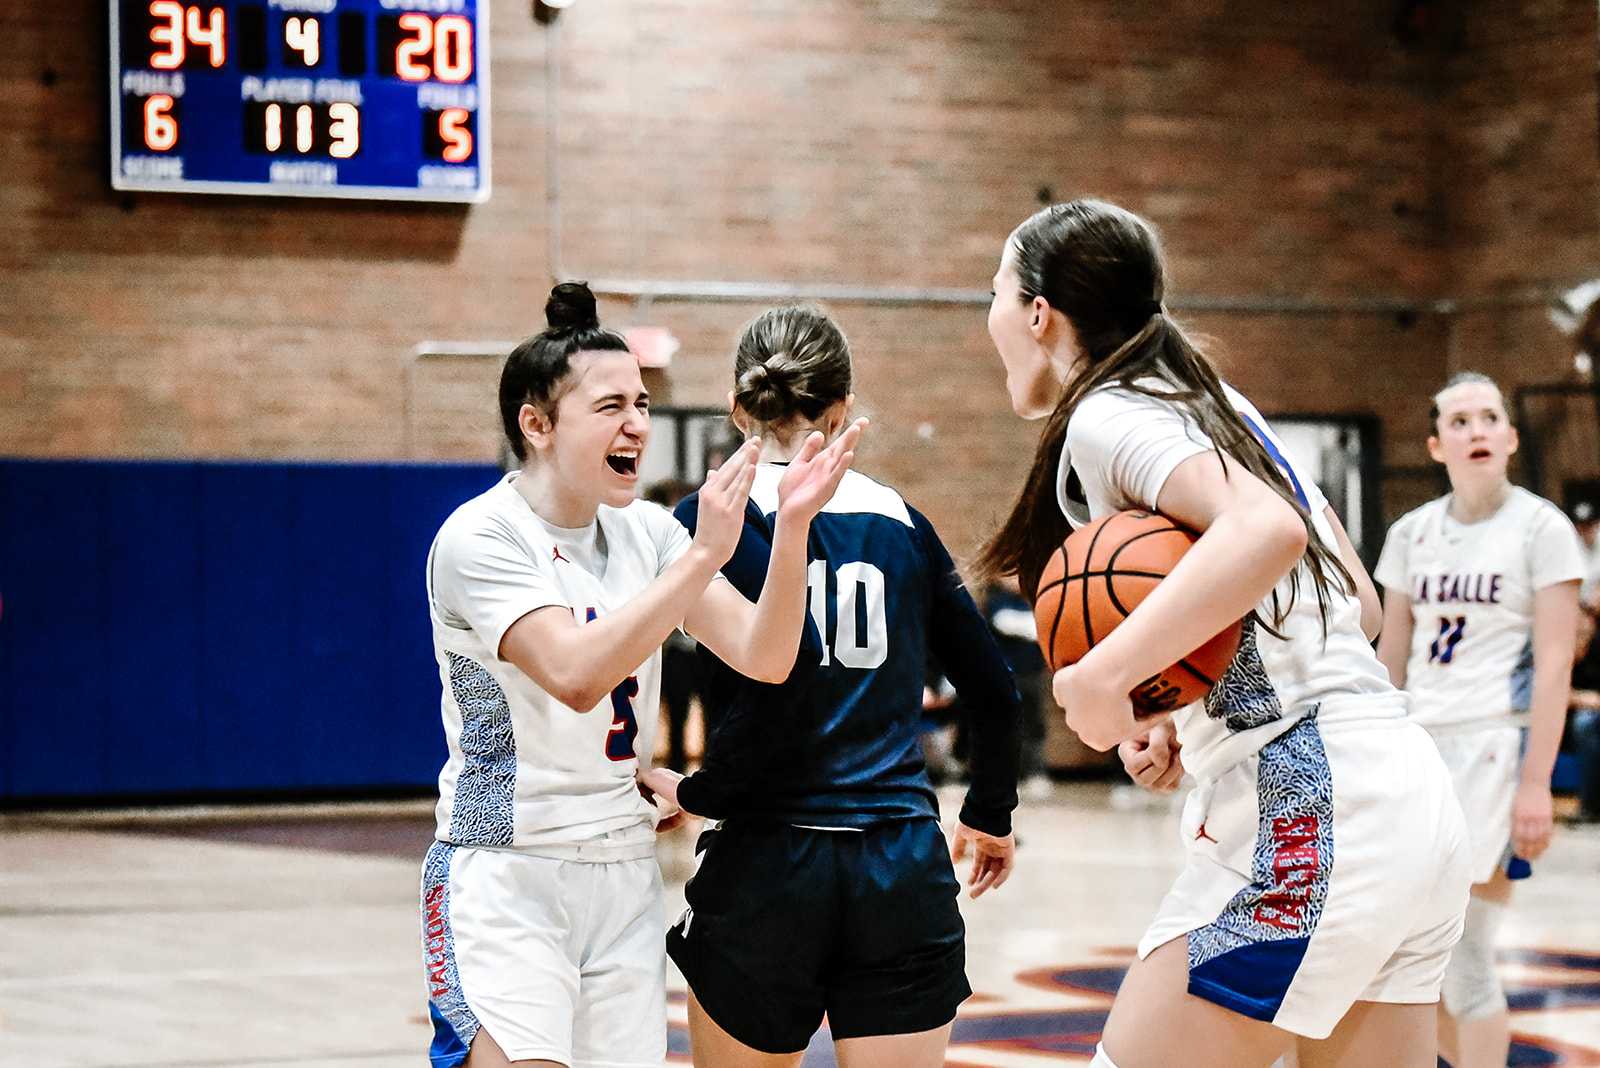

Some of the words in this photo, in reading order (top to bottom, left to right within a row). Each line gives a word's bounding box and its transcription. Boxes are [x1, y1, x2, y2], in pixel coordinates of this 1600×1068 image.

[150, 0, 226, 68] 34
[285, 17, 319, 67] 4
[395, 13, 472, 82] 20
[144, 94, 178, 151] 6
[439, 107, 473, 162] 5
[806, 559, 888, 669] 10
[1437, 573, 1503, 604] SALLE
